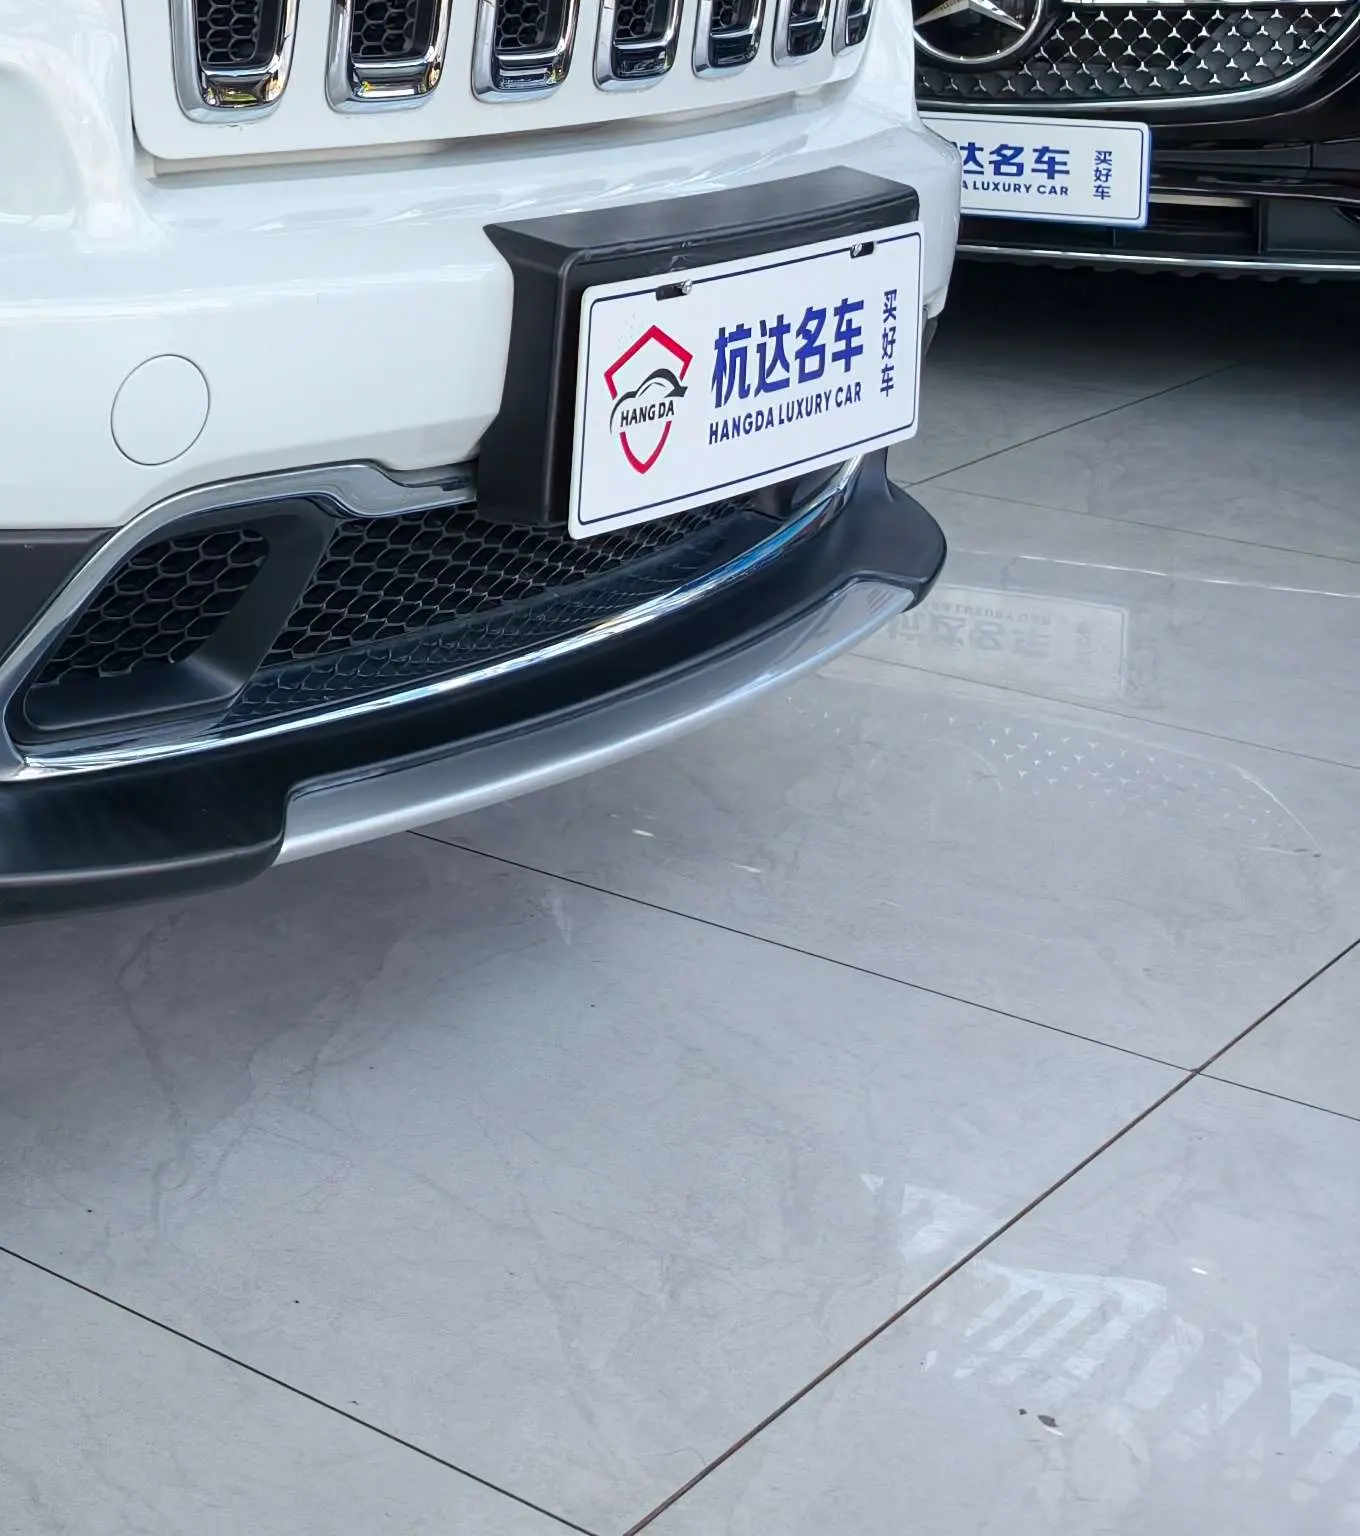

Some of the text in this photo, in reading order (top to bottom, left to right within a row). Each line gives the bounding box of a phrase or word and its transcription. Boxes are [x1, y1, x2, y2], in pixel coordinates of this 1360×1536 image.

[973, 180, 1032, 194] LUXURY
[1036, 184, 1069, 196] CAR
[1092, 149, 1112, 201] 买好车
[710, 297, 865, 409] 杭达名车
[879, 288, 899, 398] 买好车
[619, 399, 675, 428] HANG DA
[708, 381, 862, 445] HANGDA LUXURY CAR
